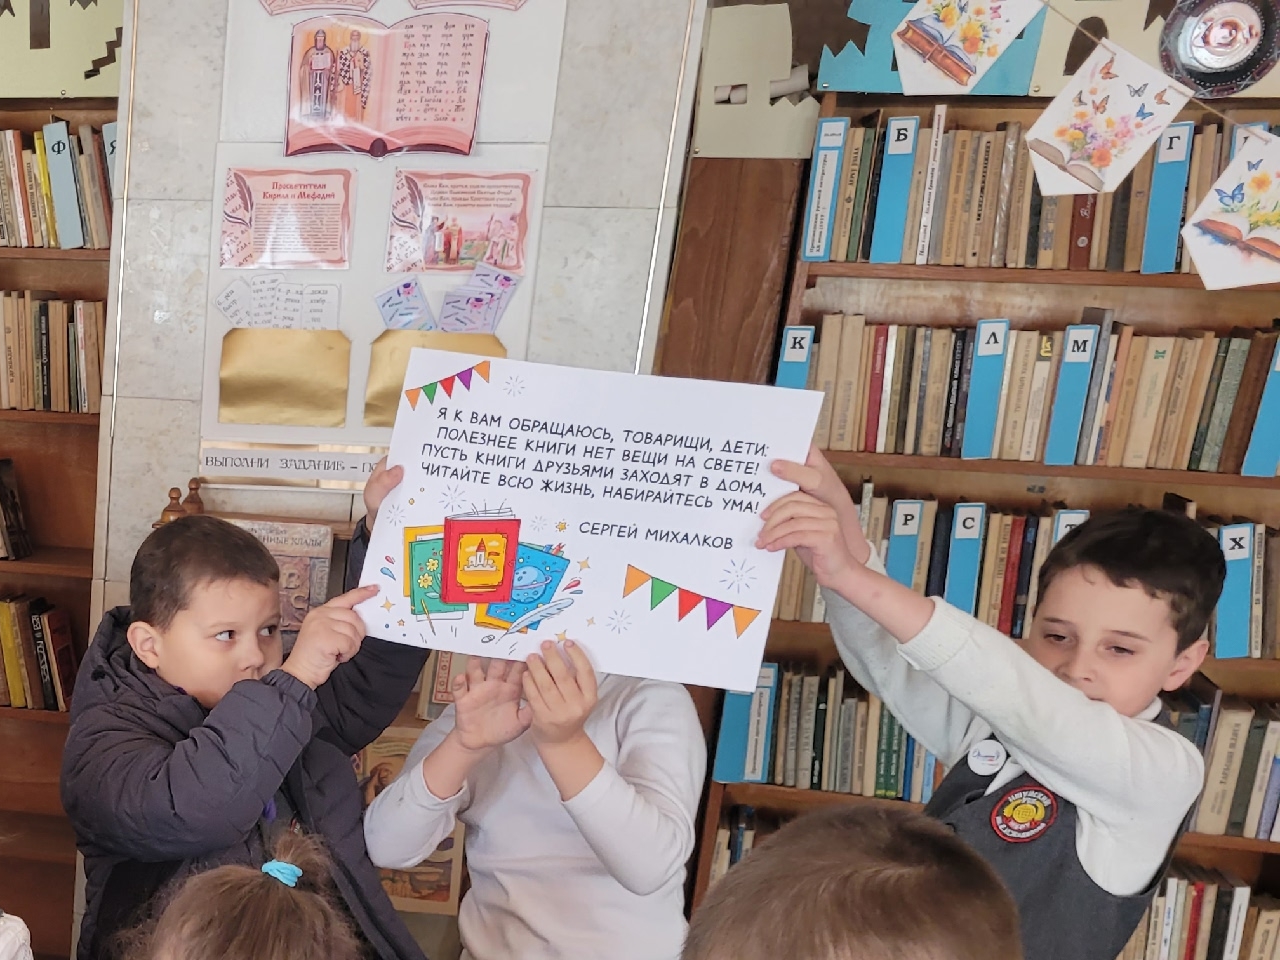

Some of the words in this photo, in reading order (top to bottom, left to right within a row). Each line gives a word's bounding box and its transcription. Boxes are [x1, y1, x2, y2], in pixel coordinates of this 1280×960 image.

[894, 127, 909, 142] Б
[51, 139, 67, 155] Ф
[1165, 135, 1182, 151] Г
[790, 336, 806, 351] К
[984, 332, 999, 345] Л
[1071, 338, 1088, 354] М
[436, 407, 448, 420] Я
[453, 409, 463, 423] К
[470, 411, 502, 428] ВАМ
[509, 417, 614, 443] ОБРАЩАЮСЬ,
[622, 429, 713, 452] ТОВАРИЩИ,
[720, 439, 770, 457] ДЕТИ:
[436, 426, 518, 450] ПОЛЕЗНЕЕ
[524, 439, 576, 456] КНИГИ
[583, 445, 615, 460] НЕТ
[621, 449, 669, 467] ВЕЩИ
[675, 454, 696, 468] НА
[703, 457, 760, 475] СВЕТЕ!
[205, 456, 269, 469] ВЫПОЛНИ
[279, 459, 346, 471] ЗАДАНИЕ
[421, 443, 468, 461] ПУСТЬ
[475, 451, 526, 470] КНИГИ
[532, 460, 614, 479] ДРУЗЬЯМИ
[620, 469, 693, 488] ЗАХОДЯТ
[699, 477, 709, 488] В
[715, 479, 766, 497] ДОМА,
[421, 462, 491, 485] ЧИТАЙТЕ
[497, 474, 534, 490] ВСЮ
[540, 479, 595, 499] ЖИЗНЬ,
[602, 485, 713, 508] НАБИРАЙТЕСЬ
[722, 498, 760, 514] УМА!
[901, 514, 915, 527] Р
[962, 517, 975, 530] С
[579, 522, 638, 539] СЕРГЕЙ
[645, 528, 733, 549] МИХАЛКОВ
